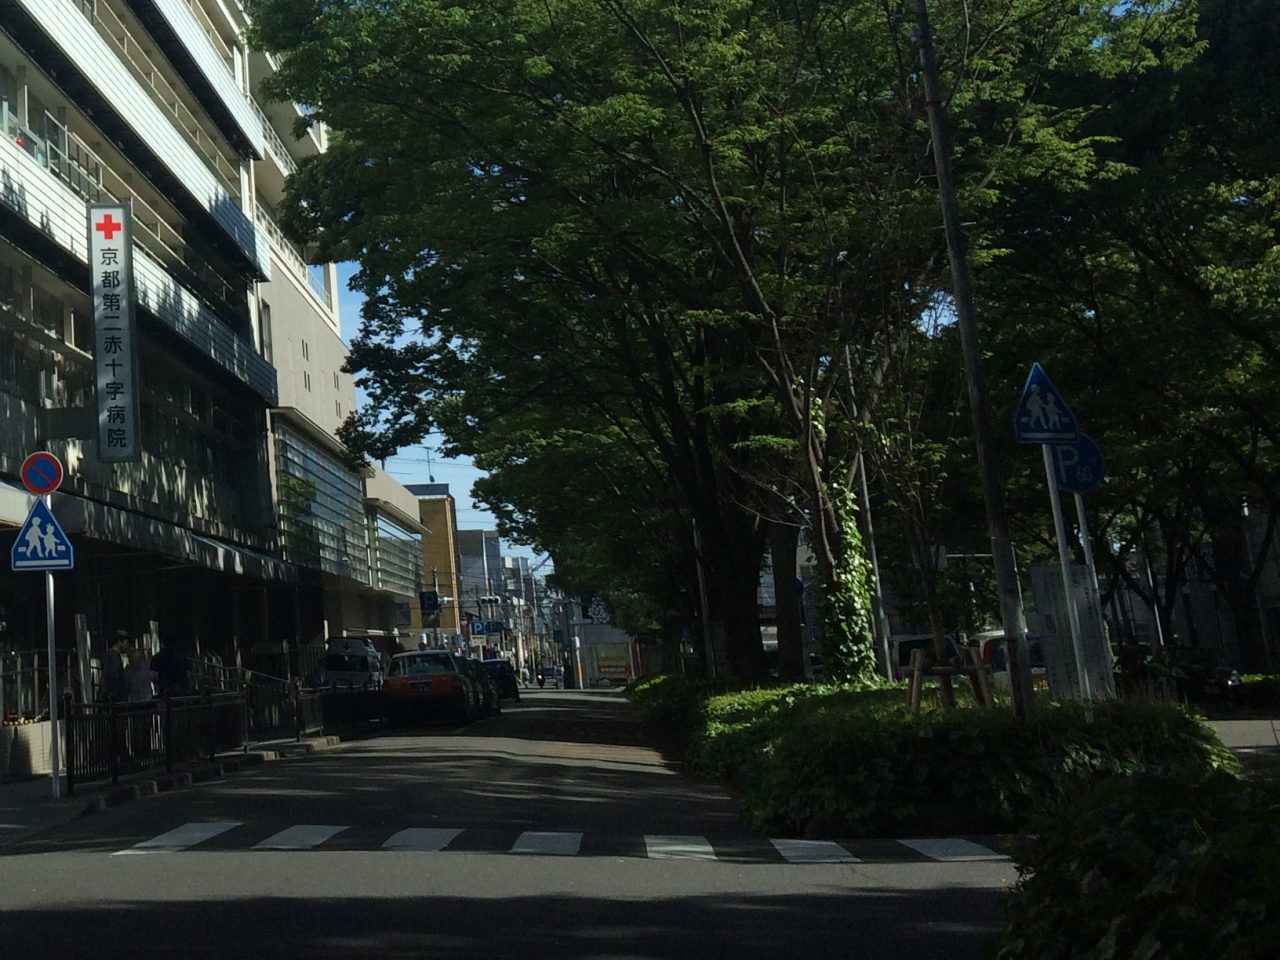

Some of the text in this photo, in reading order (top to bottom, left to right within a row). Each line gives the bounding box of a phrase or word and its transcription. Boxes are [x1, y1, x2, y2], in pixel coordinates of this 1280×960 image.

[100, 247, 127, 448] 京都第二赤十字病院
[1056, 445, 1079, 483] P
[474, 622, 482, 634] P
